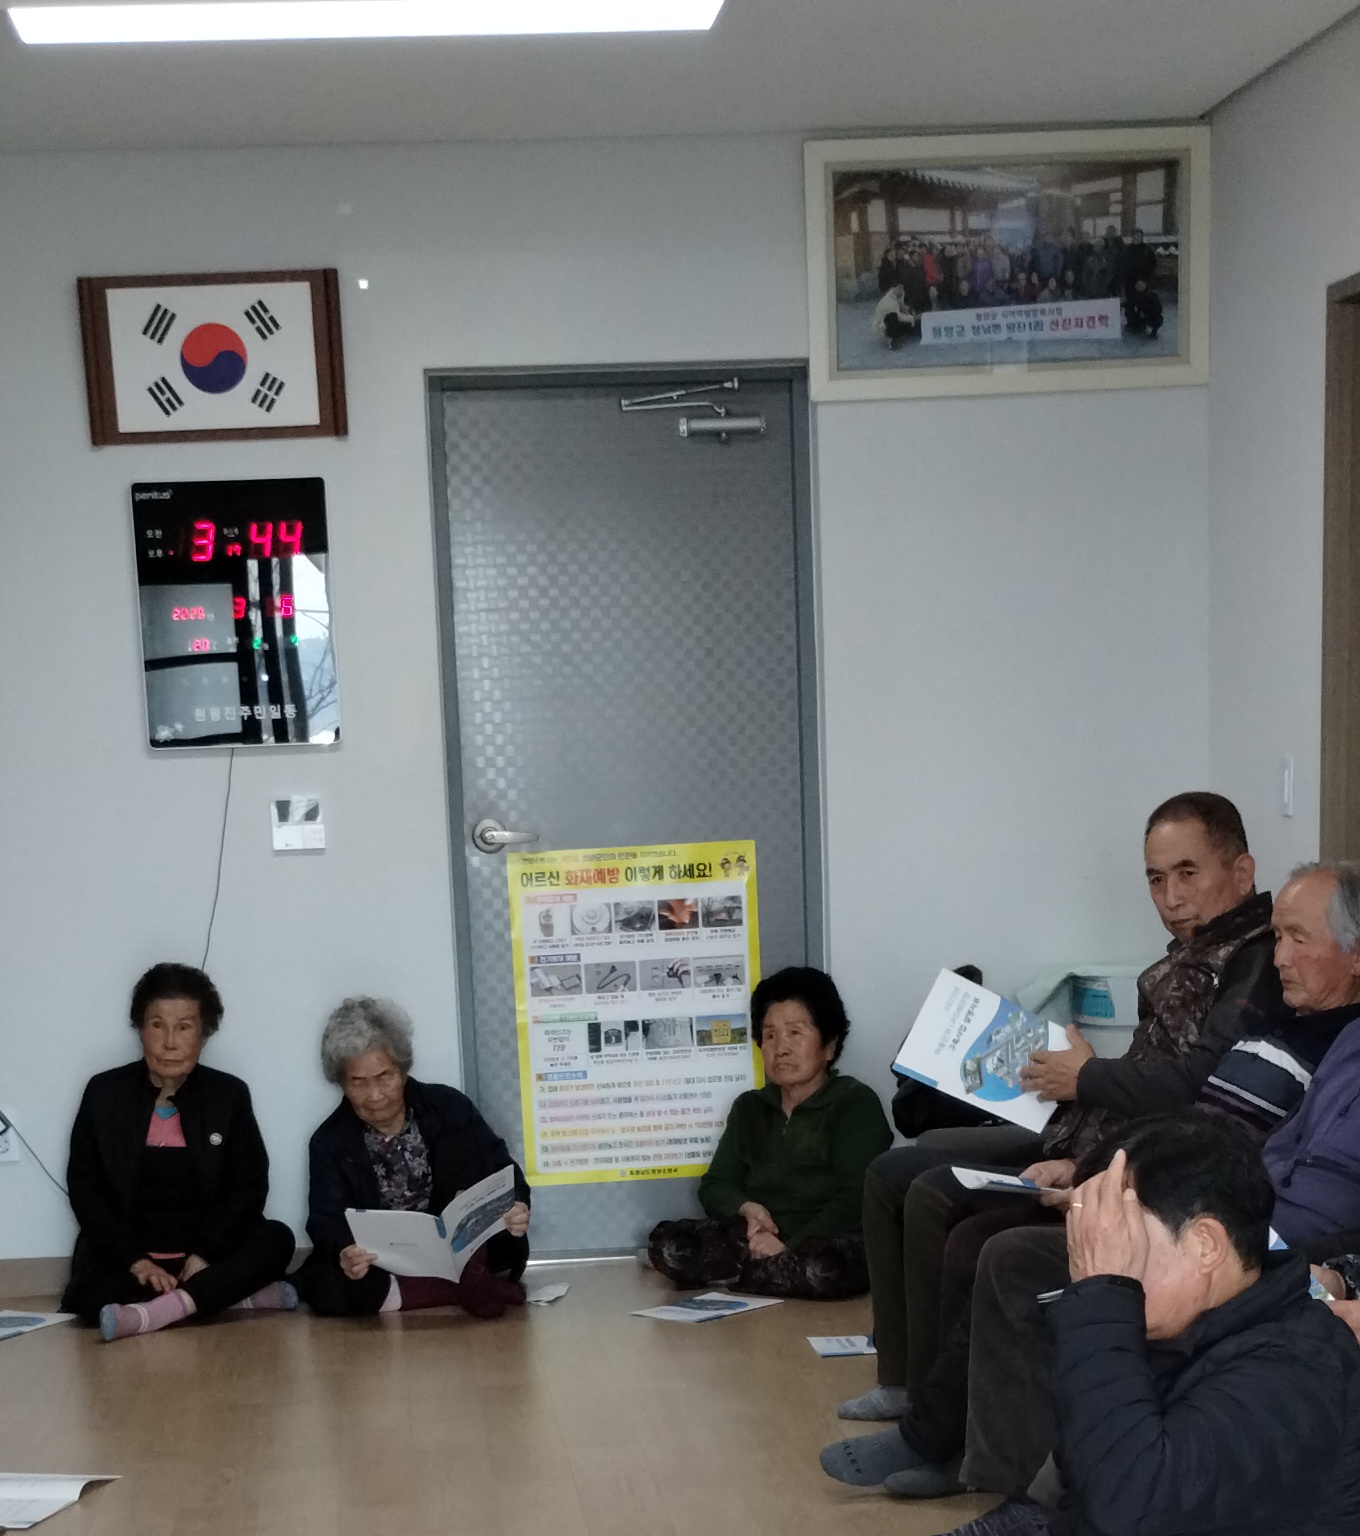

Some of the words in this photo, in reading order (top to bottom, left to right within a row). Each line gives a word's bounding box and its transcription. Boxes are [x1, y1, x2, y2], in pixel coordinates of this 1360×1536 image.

[192, 520, 216, 561] 3
[249, 521, 303, 558] 44
[233, 596, 246, 619] 3
[521, 870, 560, 888] 어르신
[564, 866, 620, 886] 화재예방
[624, 864, 664, 883] 이렇게
[668, 862, 713, 880] 하세요!
